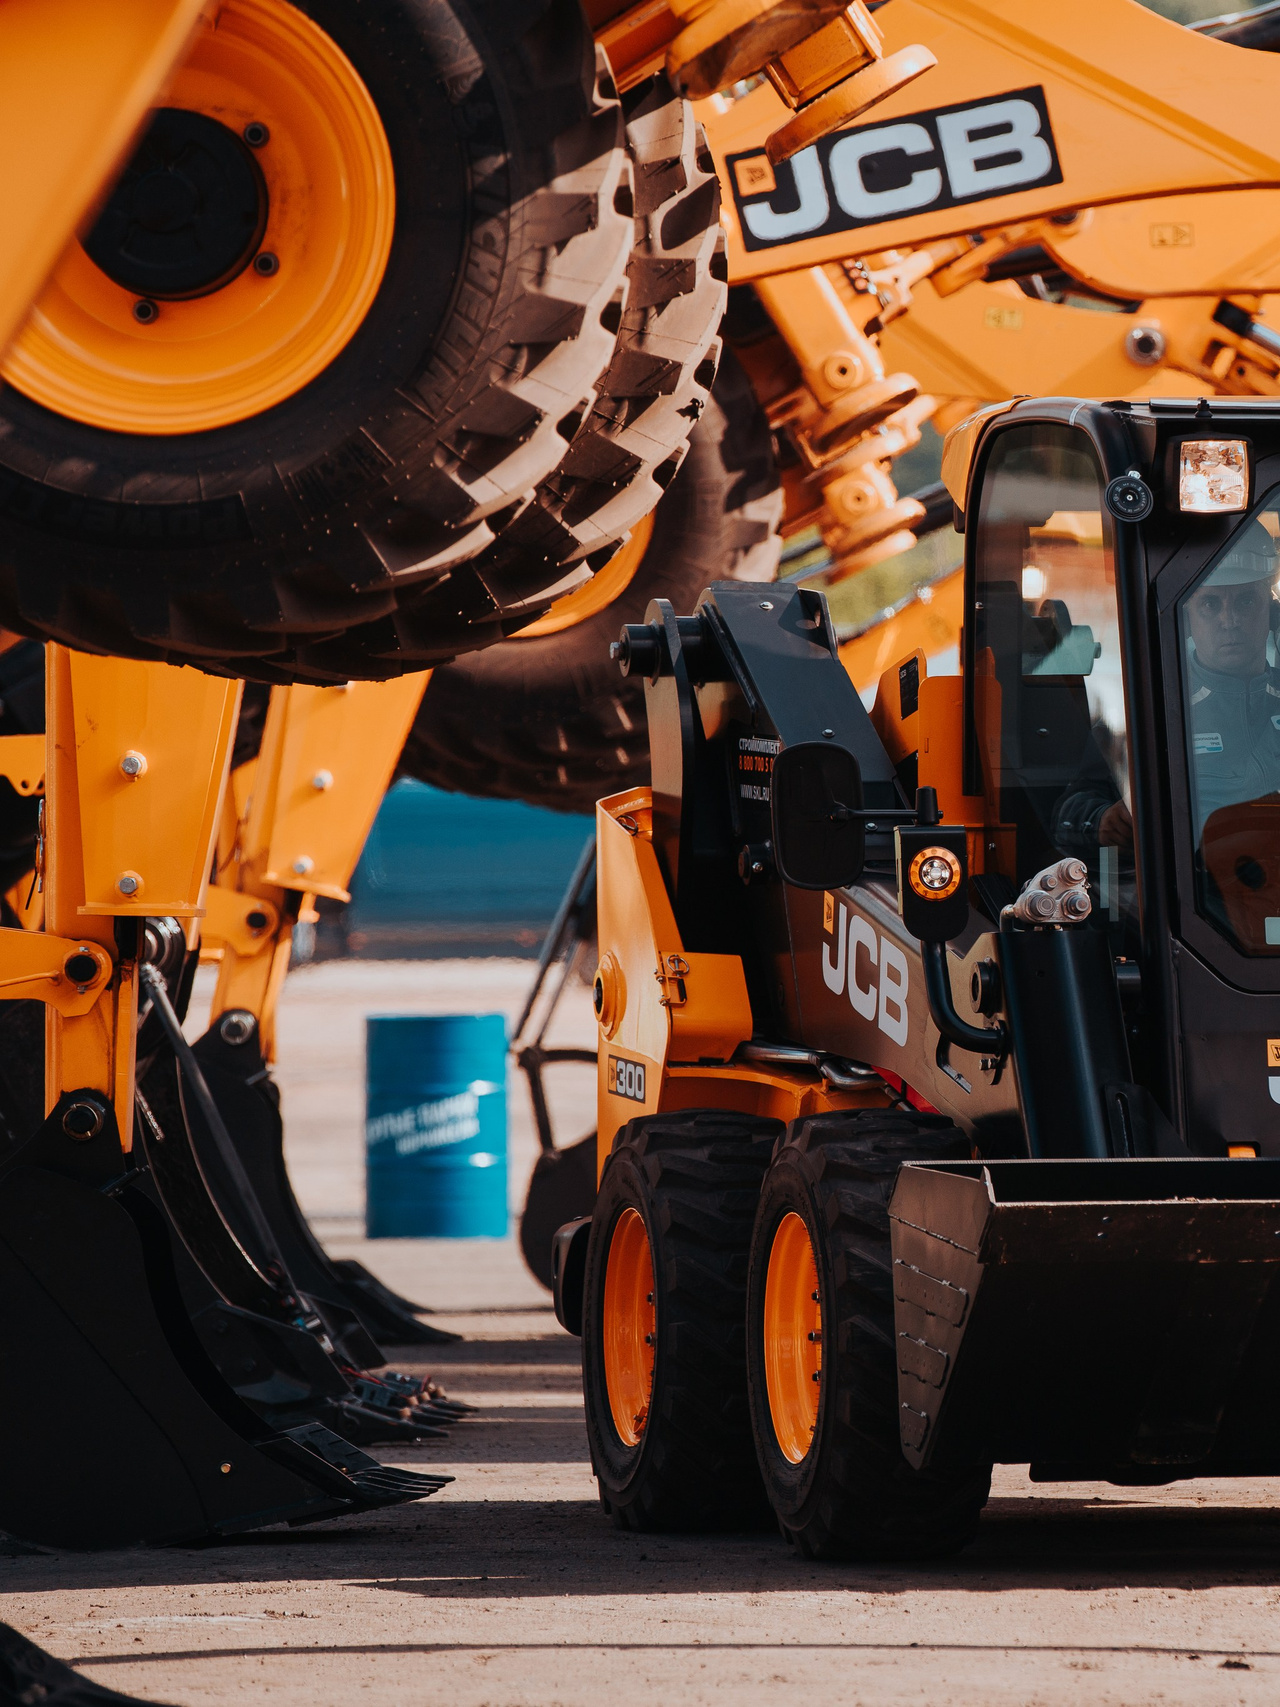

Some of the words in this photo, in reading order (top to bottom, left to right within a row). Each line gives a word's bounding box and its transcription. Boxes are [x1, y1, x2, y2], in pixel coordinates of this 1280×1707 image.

[743, 99, 1052, 241] JCB
[743, 755, 754, 771] 800
[754, 756, 765, 772] 700
[822, 902, 909, 1047] JCB
[616, 1060, 645, 1100] 300
